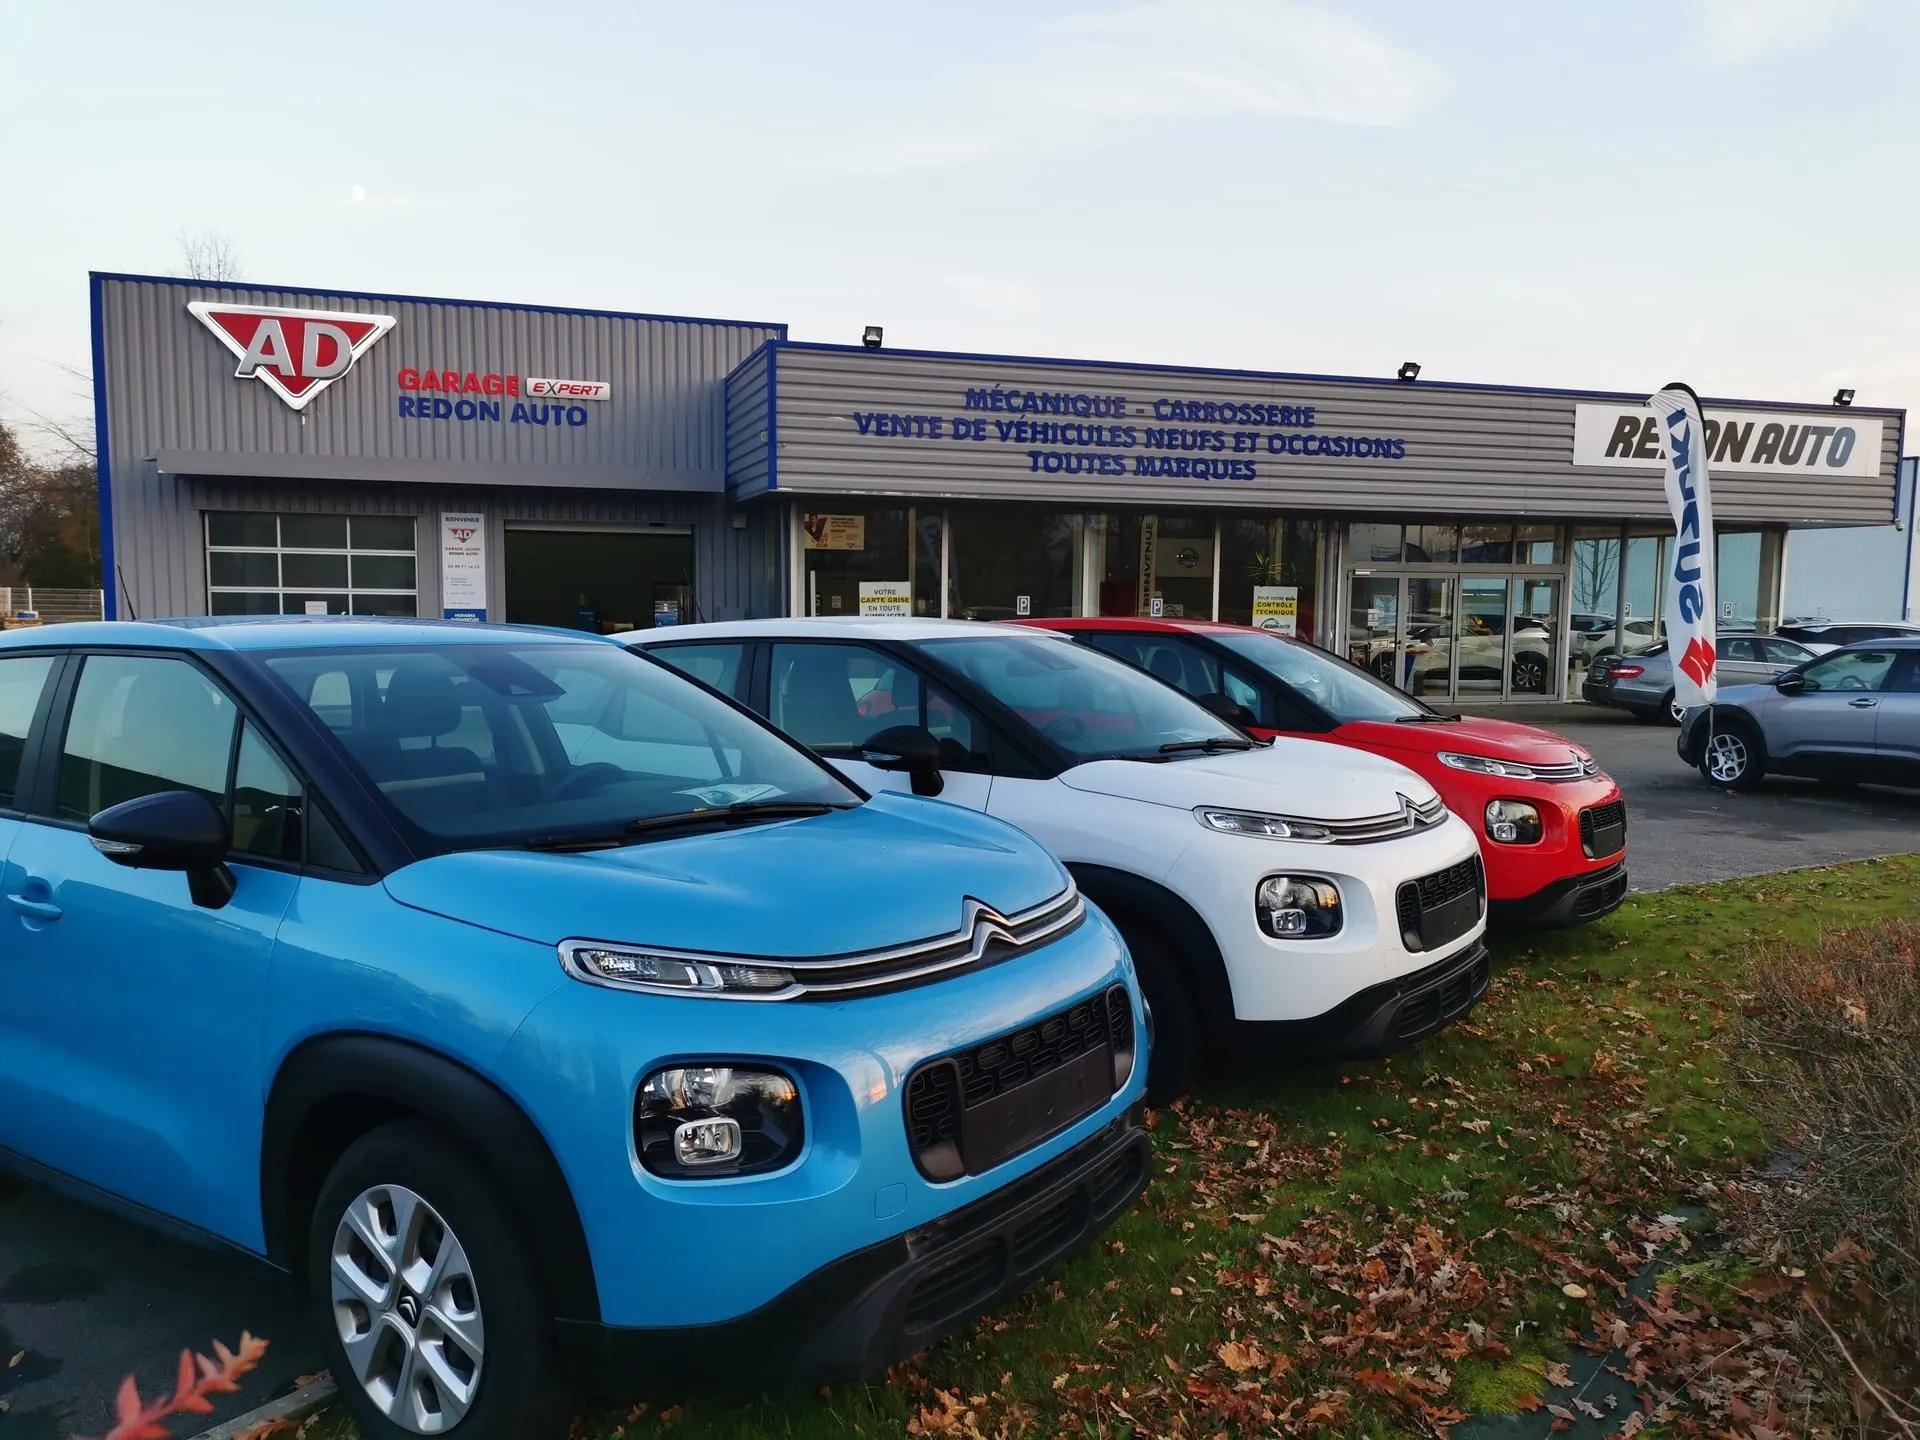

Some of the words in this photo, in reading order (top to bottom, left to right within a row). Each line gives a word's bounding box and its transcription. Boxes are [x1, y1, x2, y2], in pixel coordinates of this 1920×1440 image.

[237, 319, 352, 379] AD
[398, 368, 520, 397] GARAGE
[533, 381, 604, 396] EXPERT
[398, 396, 500, 422] REDON
[510, 403, 588, 427] AUTO
[963, 383, 1127, 419] MÉCANIQUE
[1153, 398, 1316, 428] CARROSSERIE
[853, 411, 943, 439] VENTE
[951, 416, 987, 441] DE
[996, 415, 1137, 448] VÉHICULES
[1145, 427, 1225, 452] NEUFS
[1233, 431, 1260, 454] ET
[1267, 433, 1406, 460] OCCASIONS
[1604, 415, 1755, 463] REON
[1750, 422, 1856, 468] AUTO
[1028, 450, 1126, 476] TOUTES
[1133, 455, 1257, 481] MARQUES
[456, 530, 472, 538] AD
